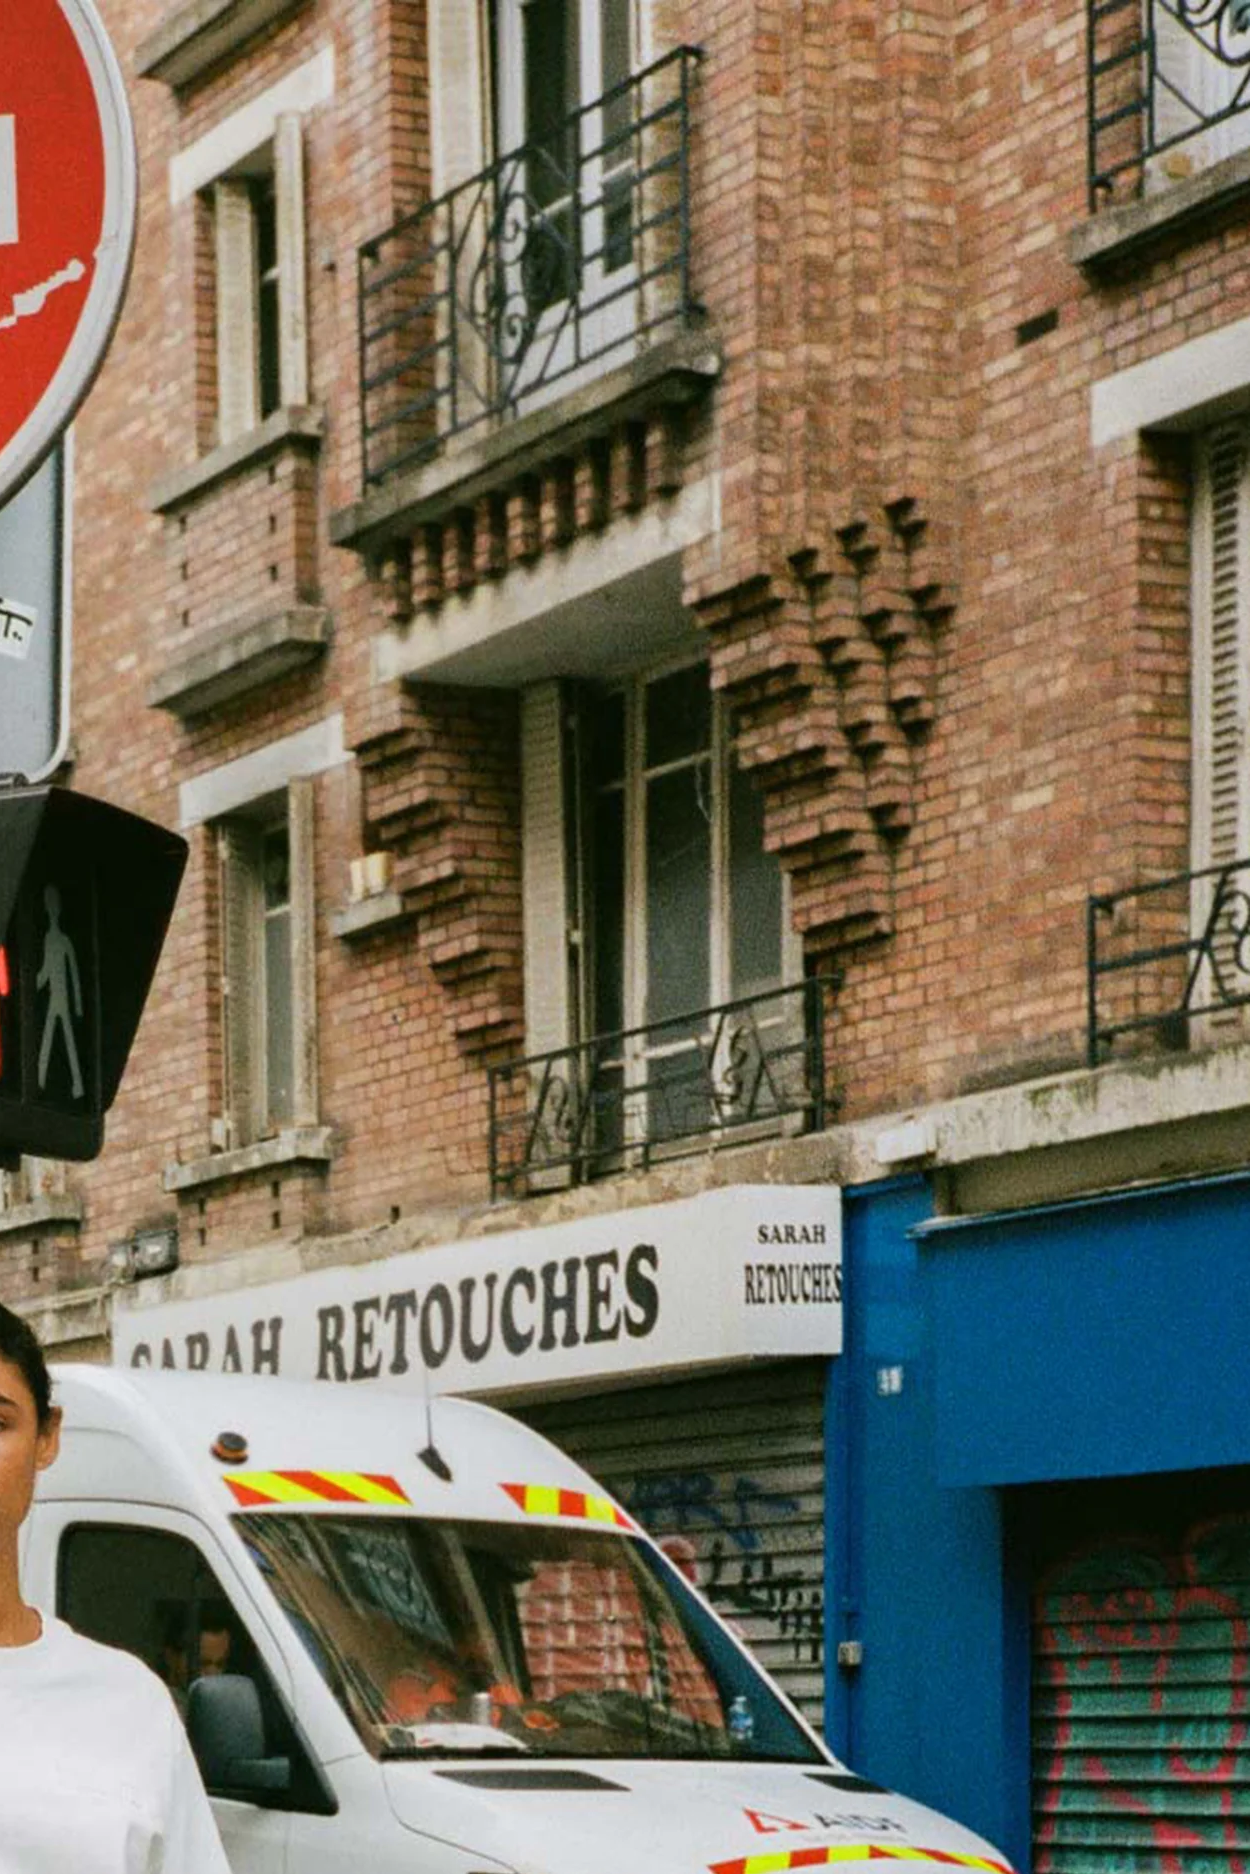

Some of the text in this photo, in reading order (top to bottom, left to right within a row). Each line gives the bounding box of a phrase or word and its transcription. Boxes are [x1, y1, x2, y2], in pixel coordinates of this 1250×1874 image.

[757, 1223, 827, 1244] SARAH
[744, 1263, 843, 1304] RETOUCHES
[315, 1244, 659, 1382] RETOUCHES
